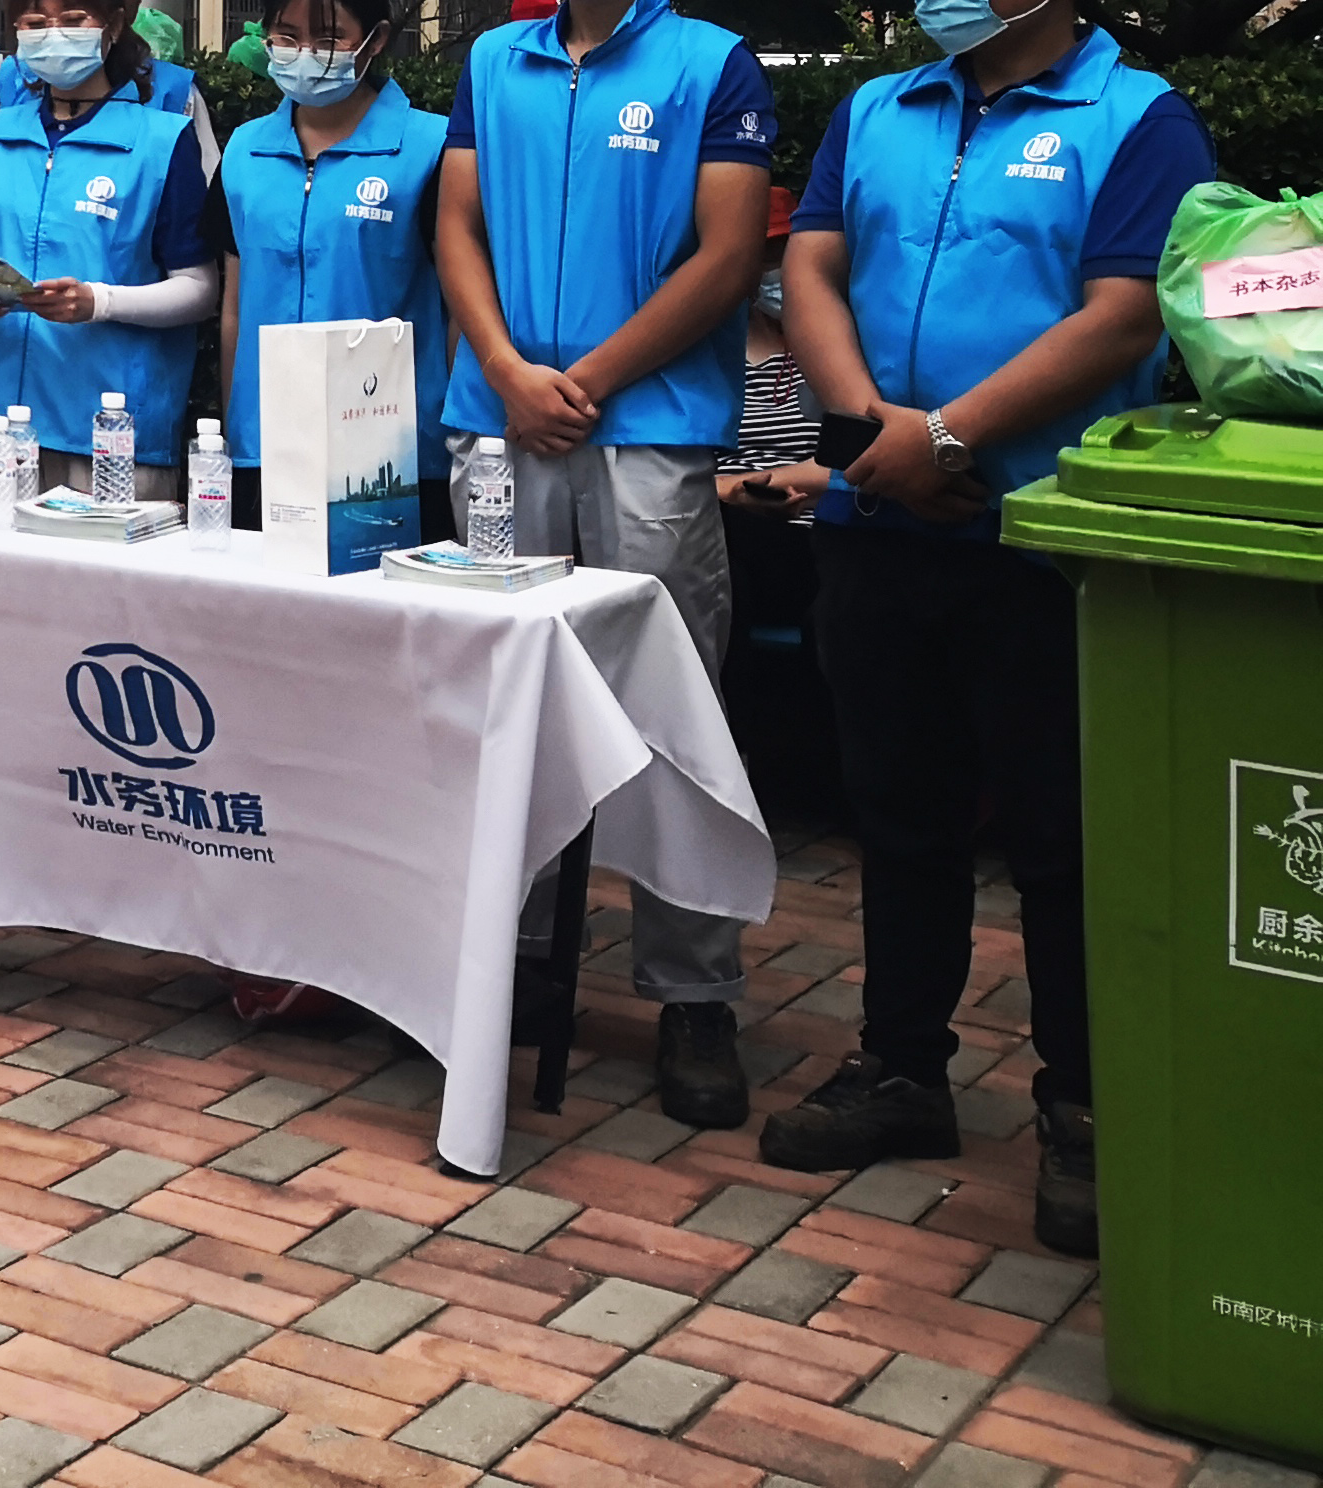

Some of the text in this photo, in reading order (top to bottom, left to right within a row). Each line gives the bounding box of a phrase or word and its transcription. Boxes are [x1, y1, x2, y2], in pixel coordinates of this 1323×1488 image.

[608, 134, 661, 153] 水务环境
[1005, 163, 1066, 182] 水务环境
[1228, 269, 1322, 297] 书本杂志
[58, 766, 267, 836] 水务环境
[72, 812, 276, 863] Water Environment
